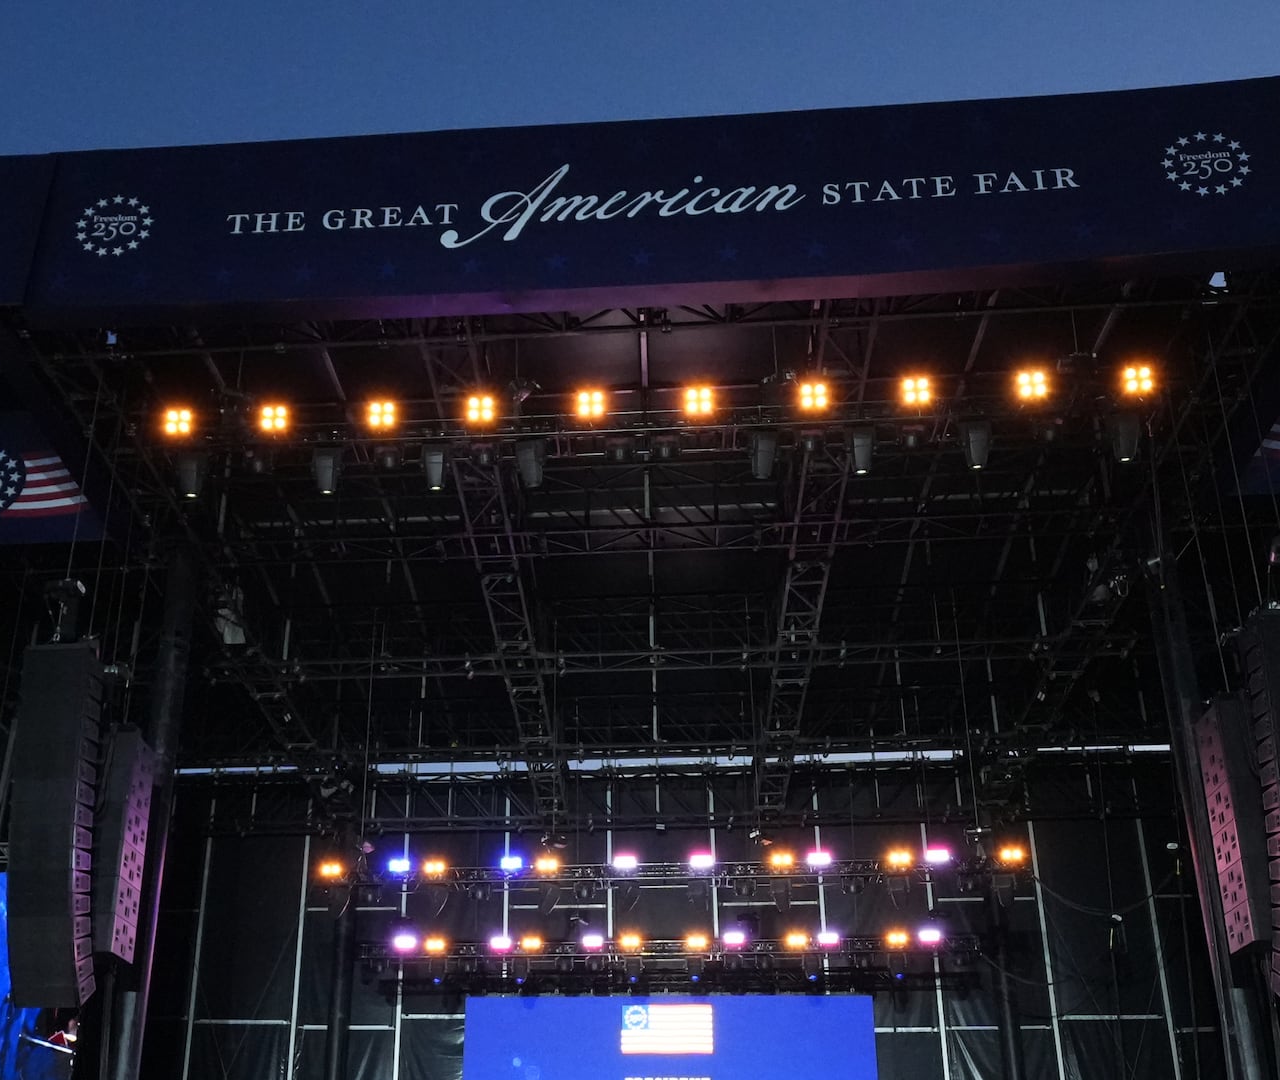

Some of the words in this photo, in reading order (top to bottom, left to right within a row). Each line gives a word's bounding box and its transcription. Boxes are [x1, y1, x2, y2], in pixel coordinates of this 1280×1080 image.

[1179, 151, 1230, 161] Freedom
[1182, 159, 1233, 180] 250
[227, 212, 305, 234] THE
[322, 204, 458, 231] GREAT
[439, 164, 805, 248] American
[822, 175, 956, 205] STATE
[973, 168, 1080, 195] FAIR
[94, 214, 137, 222] Freedom
[91, 222, 136, 241] 250
